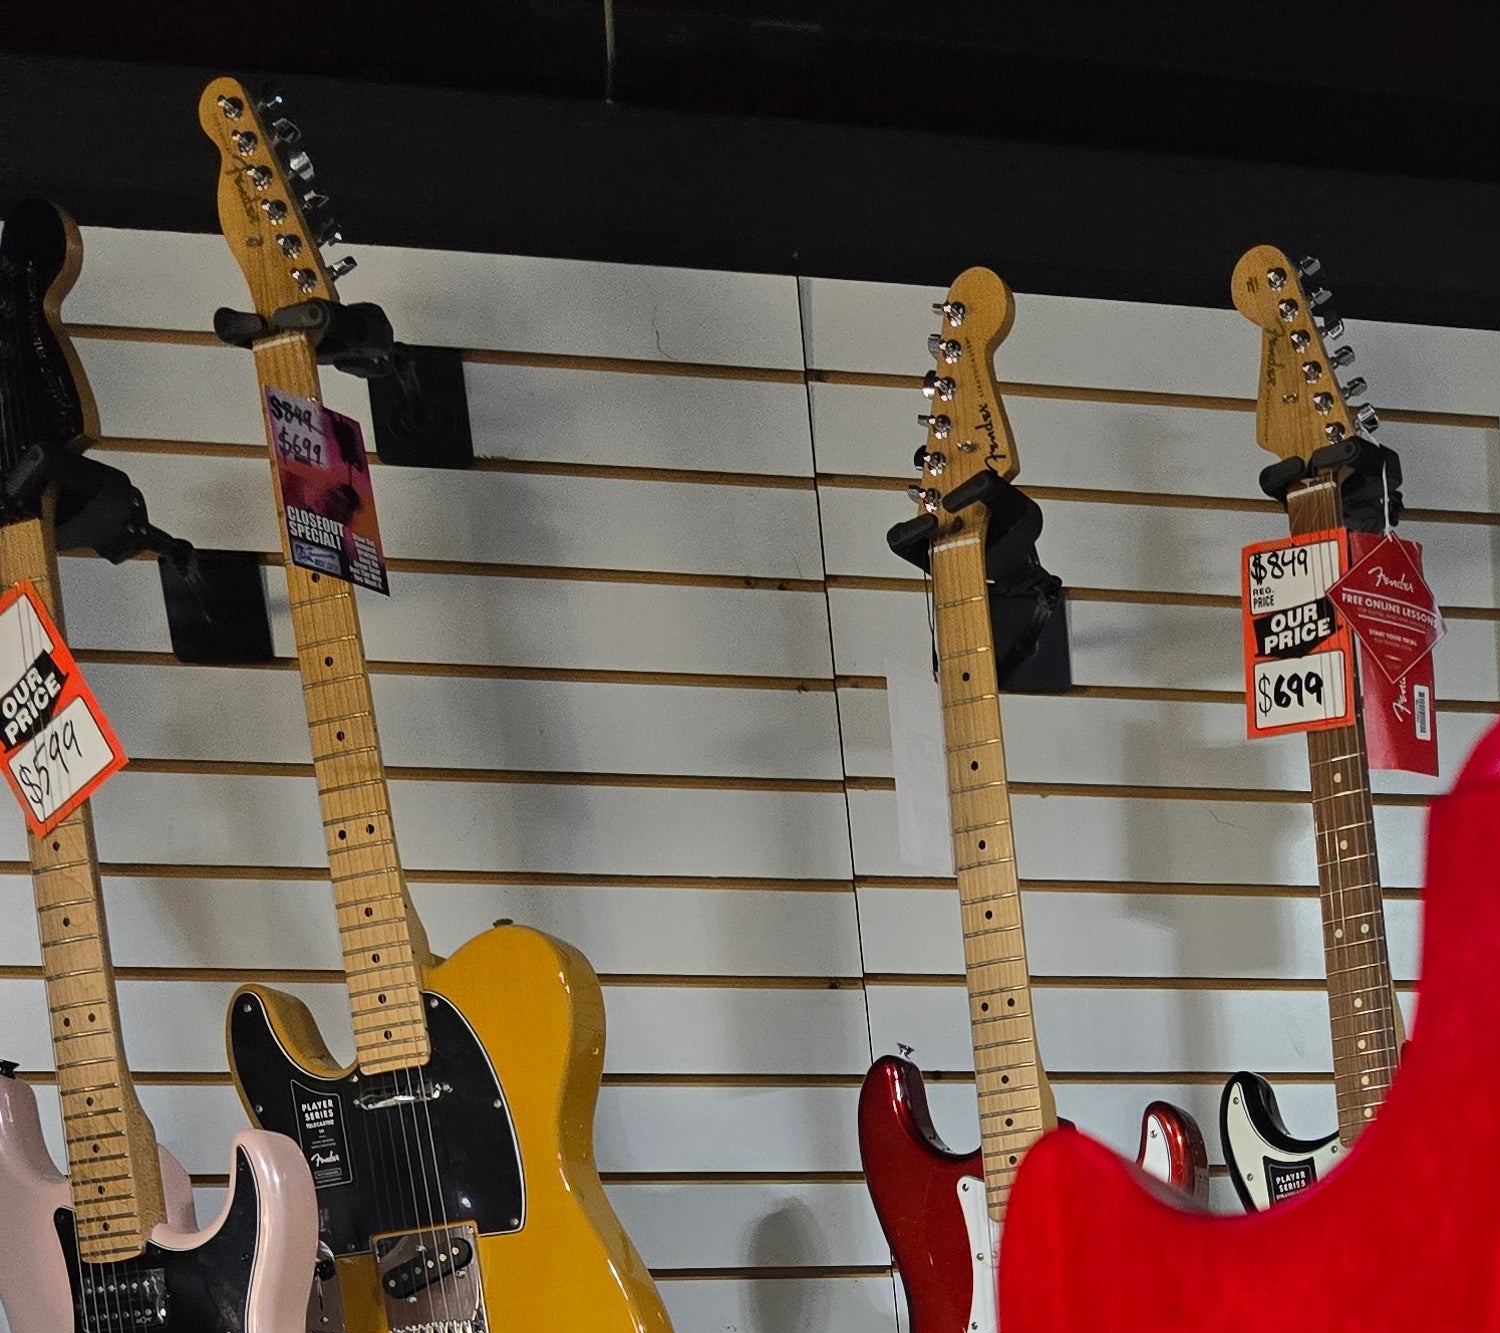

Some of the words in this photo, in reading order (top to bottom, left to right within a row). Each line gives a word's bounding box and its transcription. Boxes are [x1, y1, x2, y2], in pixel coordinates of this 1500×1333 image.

[278, 428, 324, 465] $699
[974, 402, 1006, 474] Fender
[286, 505, 344, 538] CLOSEOUT
[290, 522, 342, 551] SPECIAL!
[1250, 548, 1309, 587] $849
[1368, 565, 1415, 593] Fender
[1253, 594, 1275, 610] PRICE
[1341, 592, 1363, 607] FREE
[1365, 598, 1401, 615] ONLINE
[1270, 603, 1319, 633] OUR
[1264, 617, 1331, 656] PRICE
[3, 666, 43, 715] OUR
[1258, 671, 1324, 718] $699
[5, 671, 62, 745] PRICE
[18, 719, 83, 805] $599
[301, 1098, 334, 1112] PLAYER
[304, 1108, 334, 1122] SERIES
[310, 1150, 340, 1167] Fender
[1275, 1170, 1307, 1185] PLAYER
[1278, 1179, 1307, 1193] SERIES
